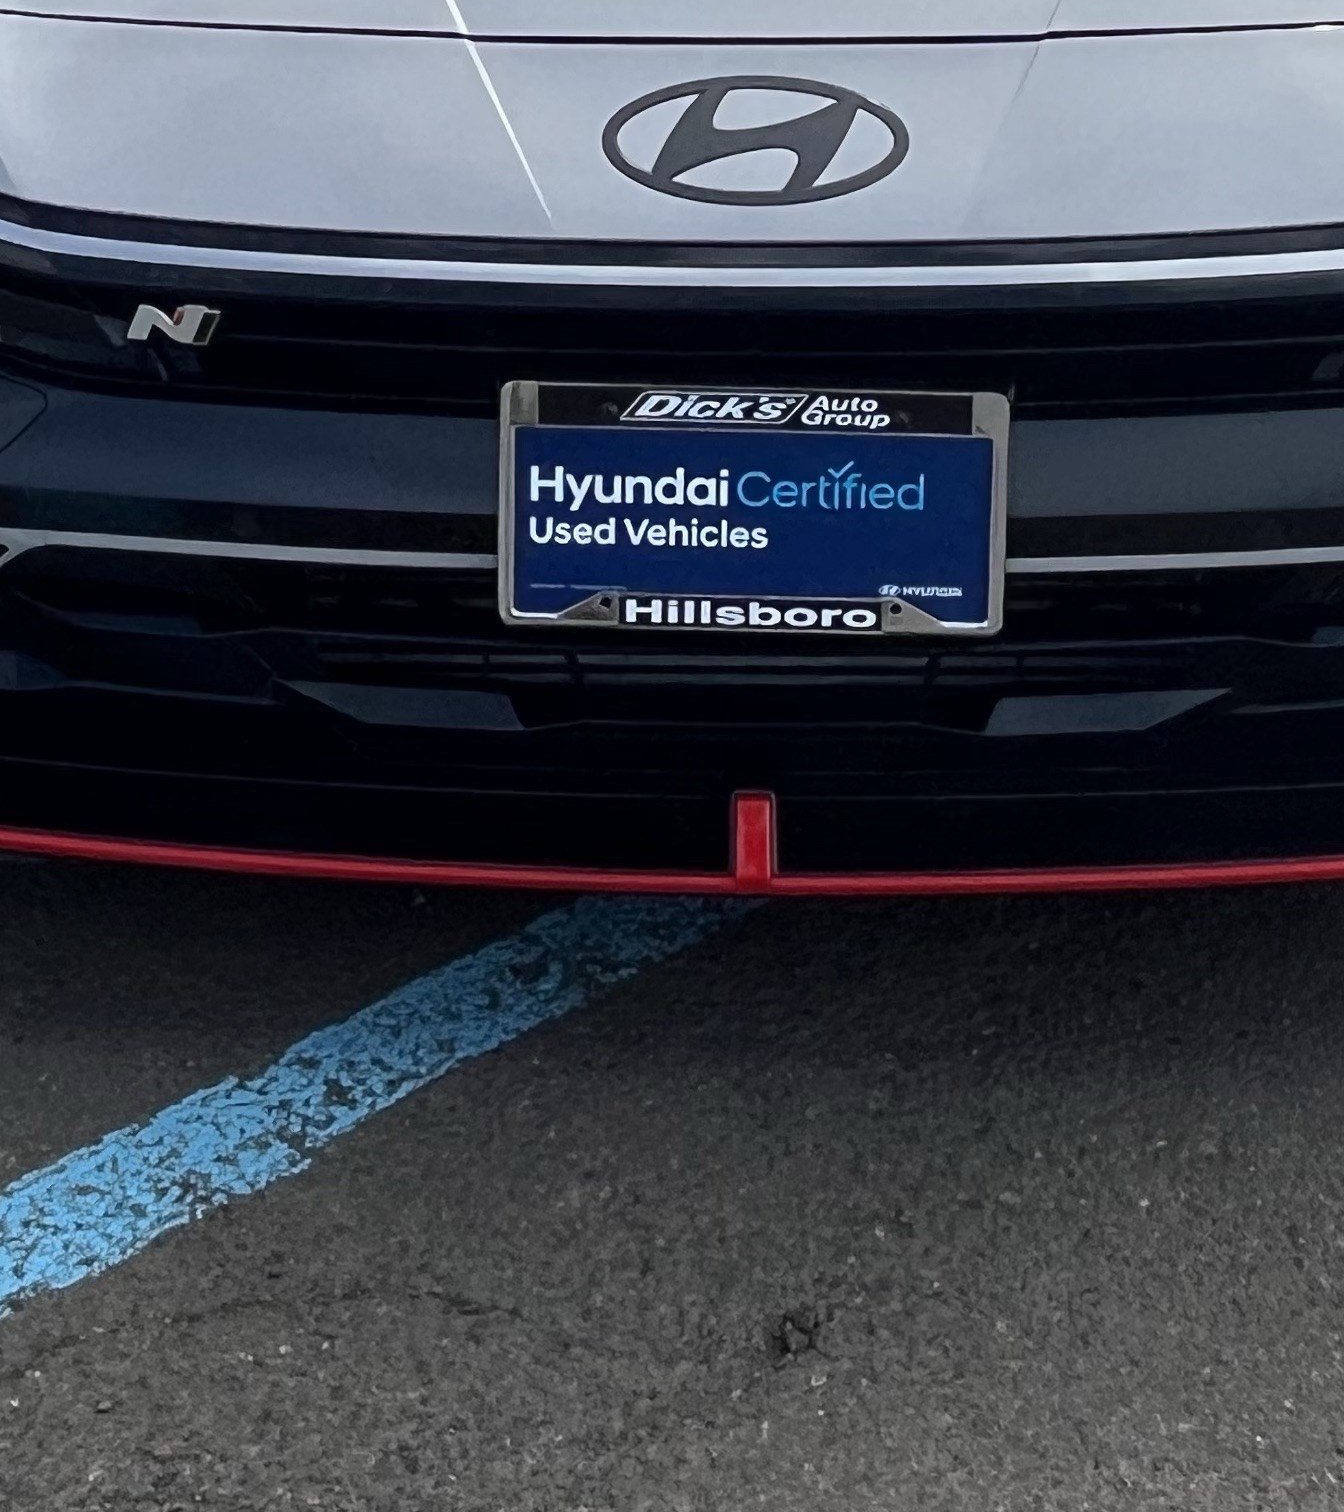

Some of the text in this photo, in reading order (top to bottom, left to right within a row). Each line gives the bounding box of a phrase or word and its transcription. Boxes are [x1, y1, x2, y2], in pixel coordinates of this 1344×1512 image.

[634, 394, 788, 420] Dick's
[806, 395, 879, 412] Auto
[800, 409, 891, 430] Group
[530, 461, 925, 512] Hyundai Certified
[529, 516, 769, 549] Used Vehicles
[625, 599, 877, 628] Hillsboro
